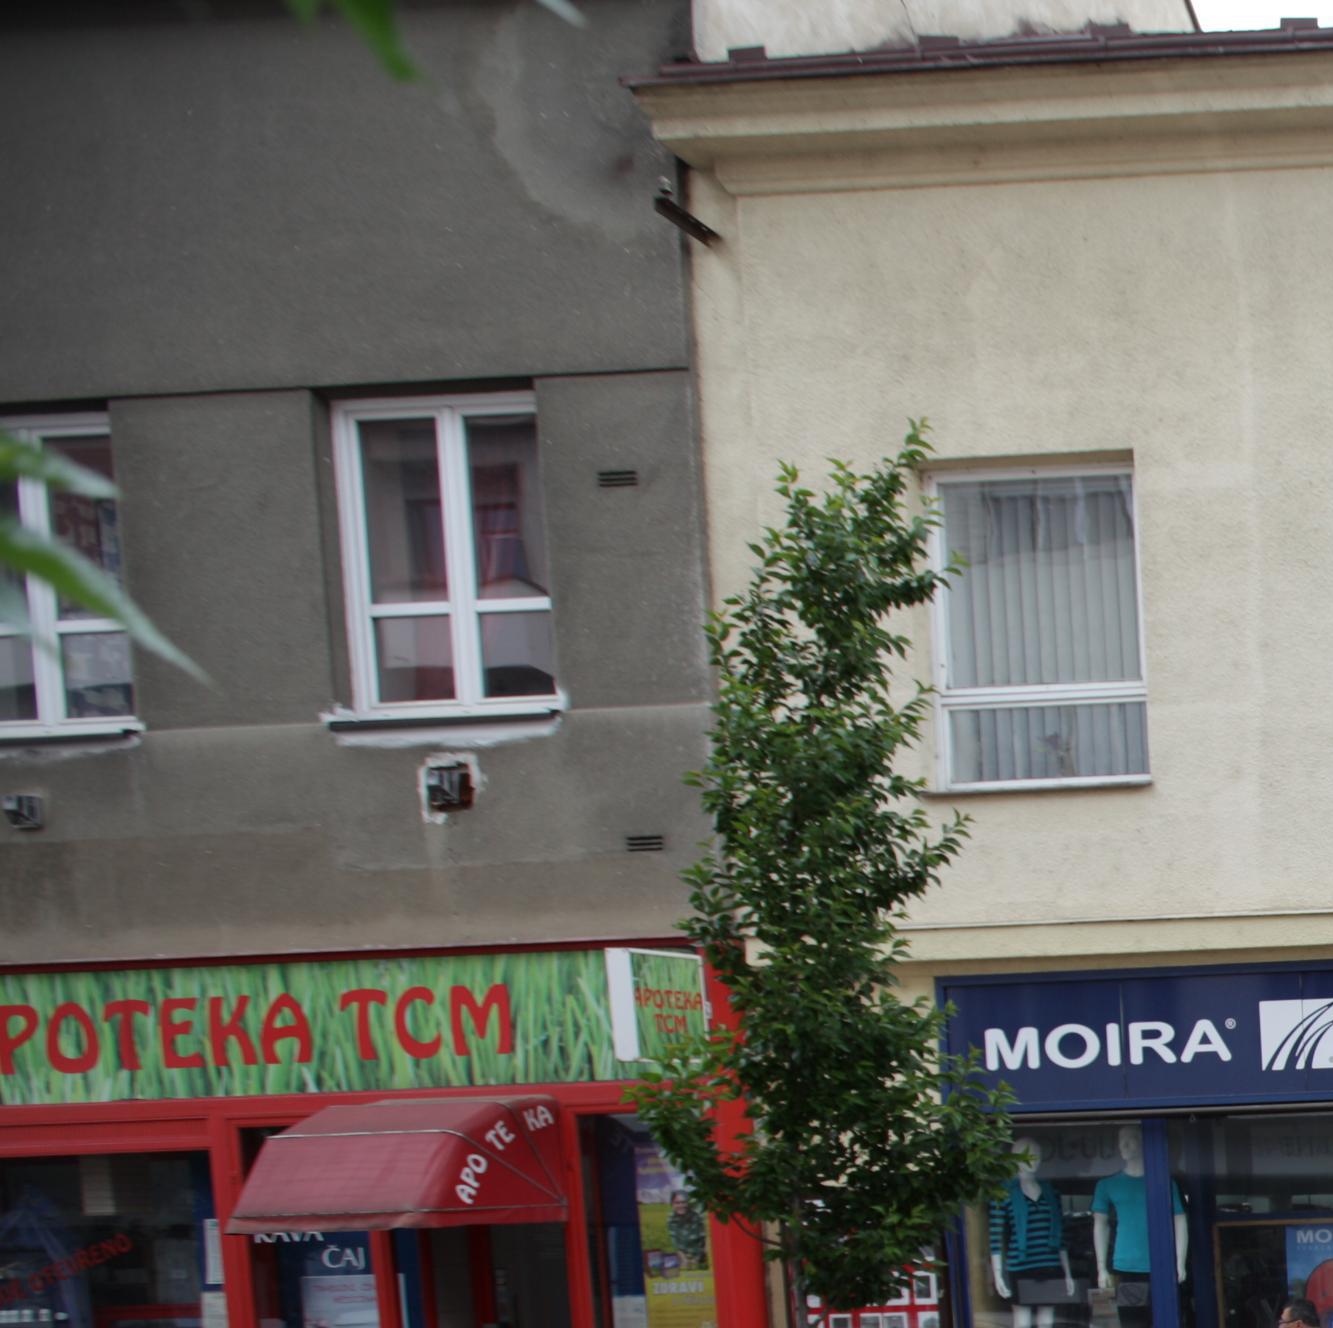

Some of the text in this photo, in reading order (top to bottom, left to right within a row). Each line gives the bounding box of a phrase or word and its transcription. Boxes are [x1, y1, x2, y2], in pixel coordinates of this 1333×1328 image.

[340, 984, 513, 1060] TCM
[654, 1013, 688, 1035] TCM
[322, 1245, 366, 1269] ČAJ
